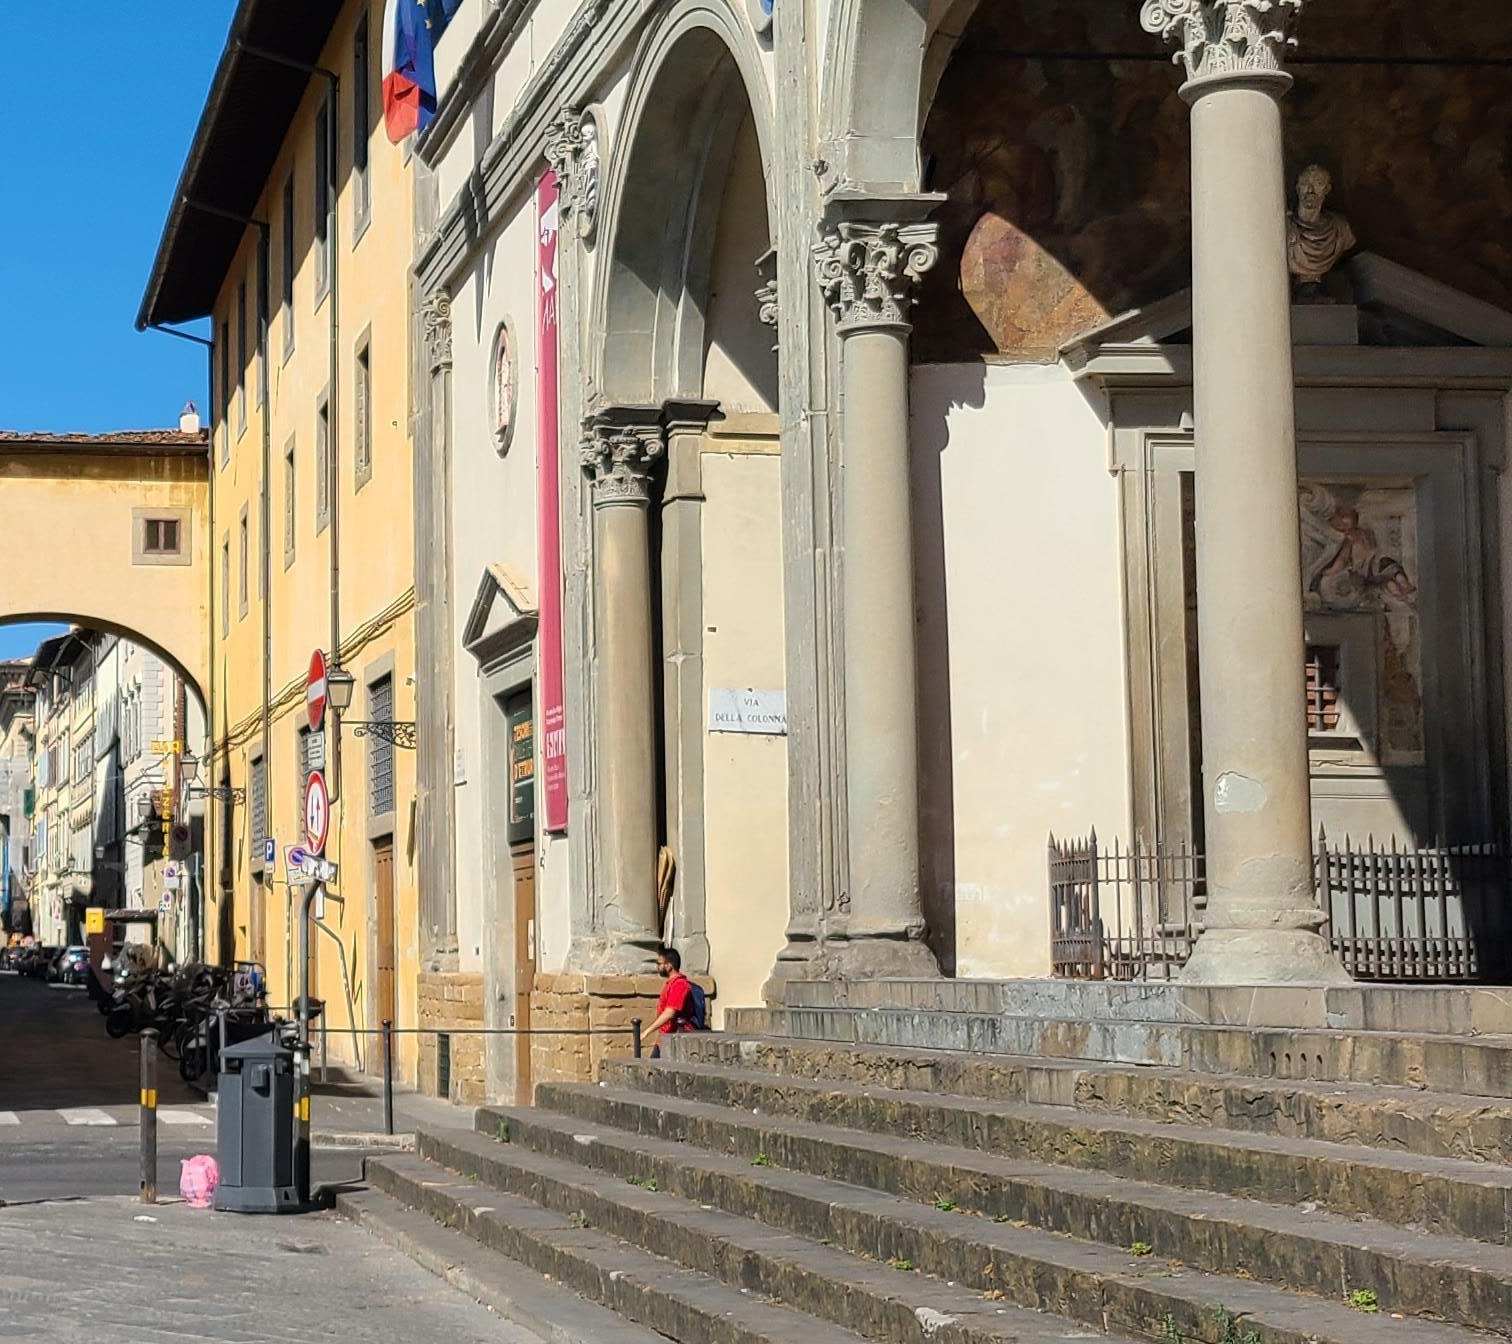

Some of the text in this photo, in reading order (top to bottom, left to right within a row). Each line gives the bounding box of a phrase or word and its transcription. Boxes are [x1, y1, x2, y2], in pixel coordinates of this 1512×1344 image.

[744, 698, 759, 706] VIA
[715, 713, 787, 724] DELLA COLONNA
[266, 841, 273, 860] P
